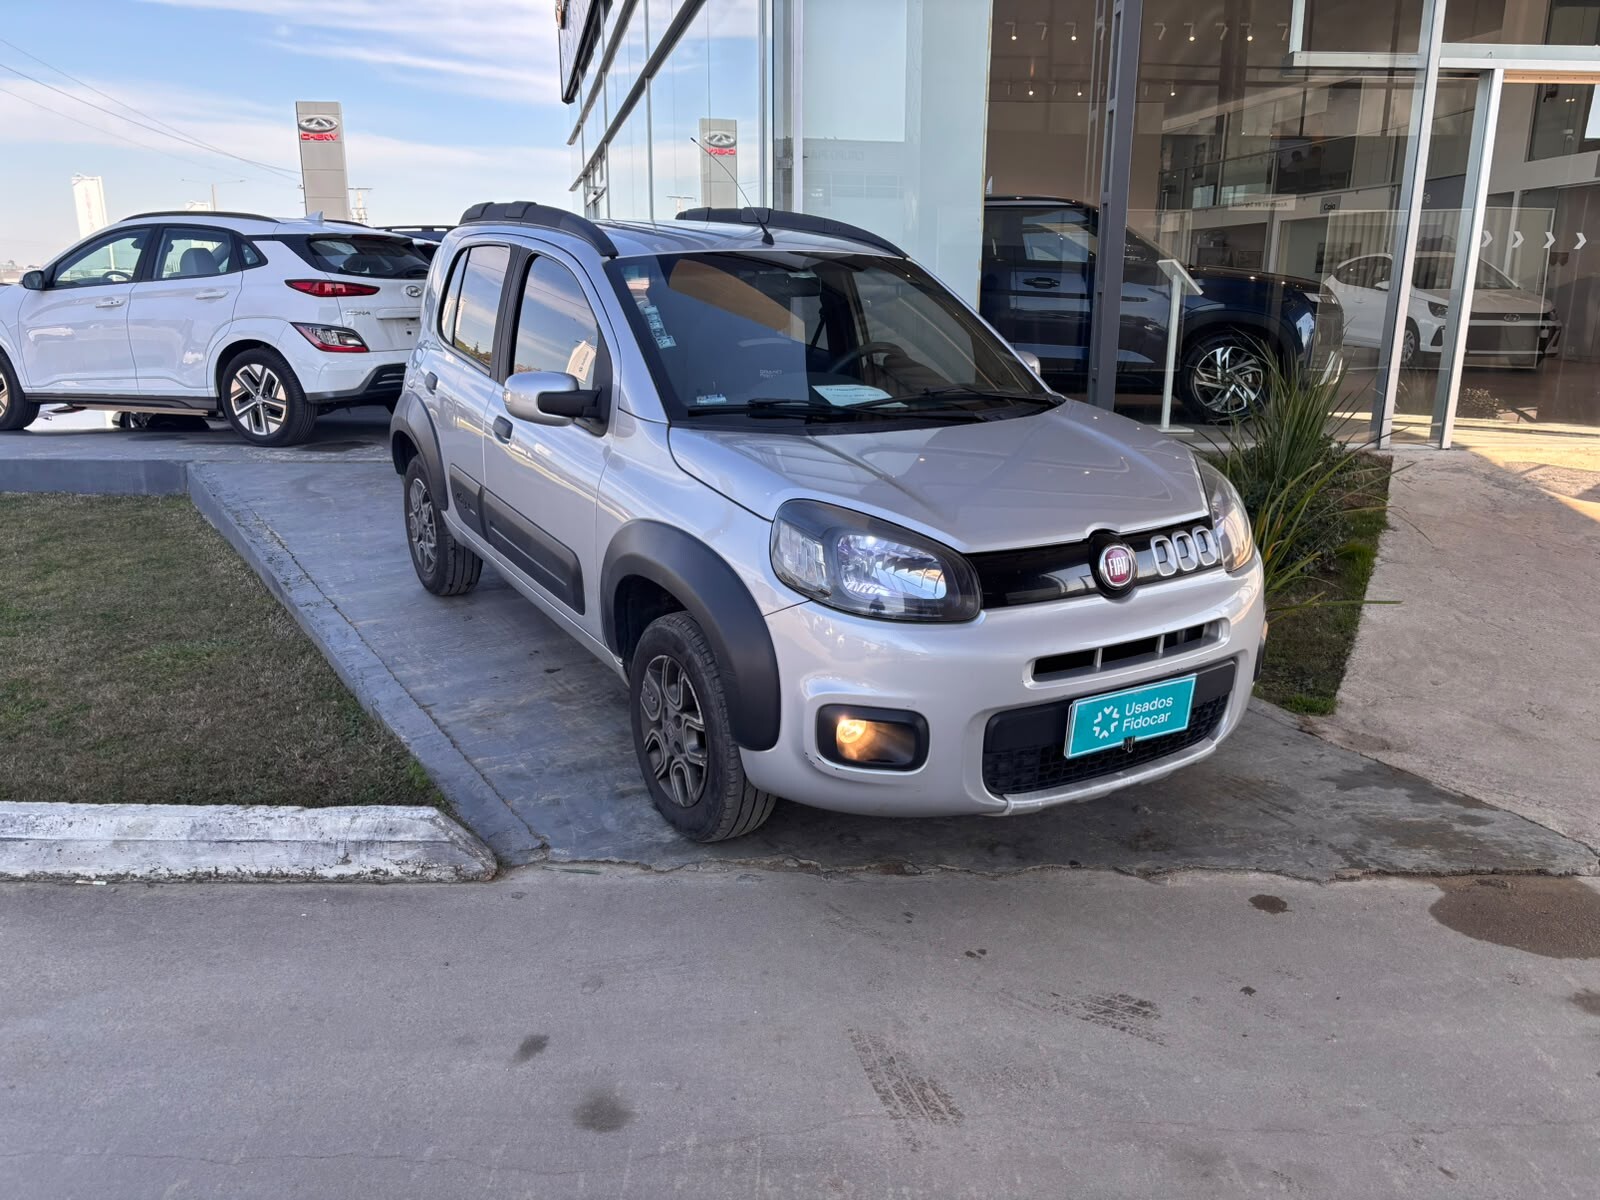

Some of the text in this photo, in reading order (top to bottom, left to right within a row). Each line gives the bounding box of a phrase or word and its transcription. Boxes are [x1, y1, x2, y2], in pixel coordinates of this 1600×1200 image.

[300, 132, 338, 141] CHERY
[1108, 556, 1126, 577] FIAT
[1125, 697, 1174, 716] Usados
[1122, 712, 1171, 732] Fidocar
